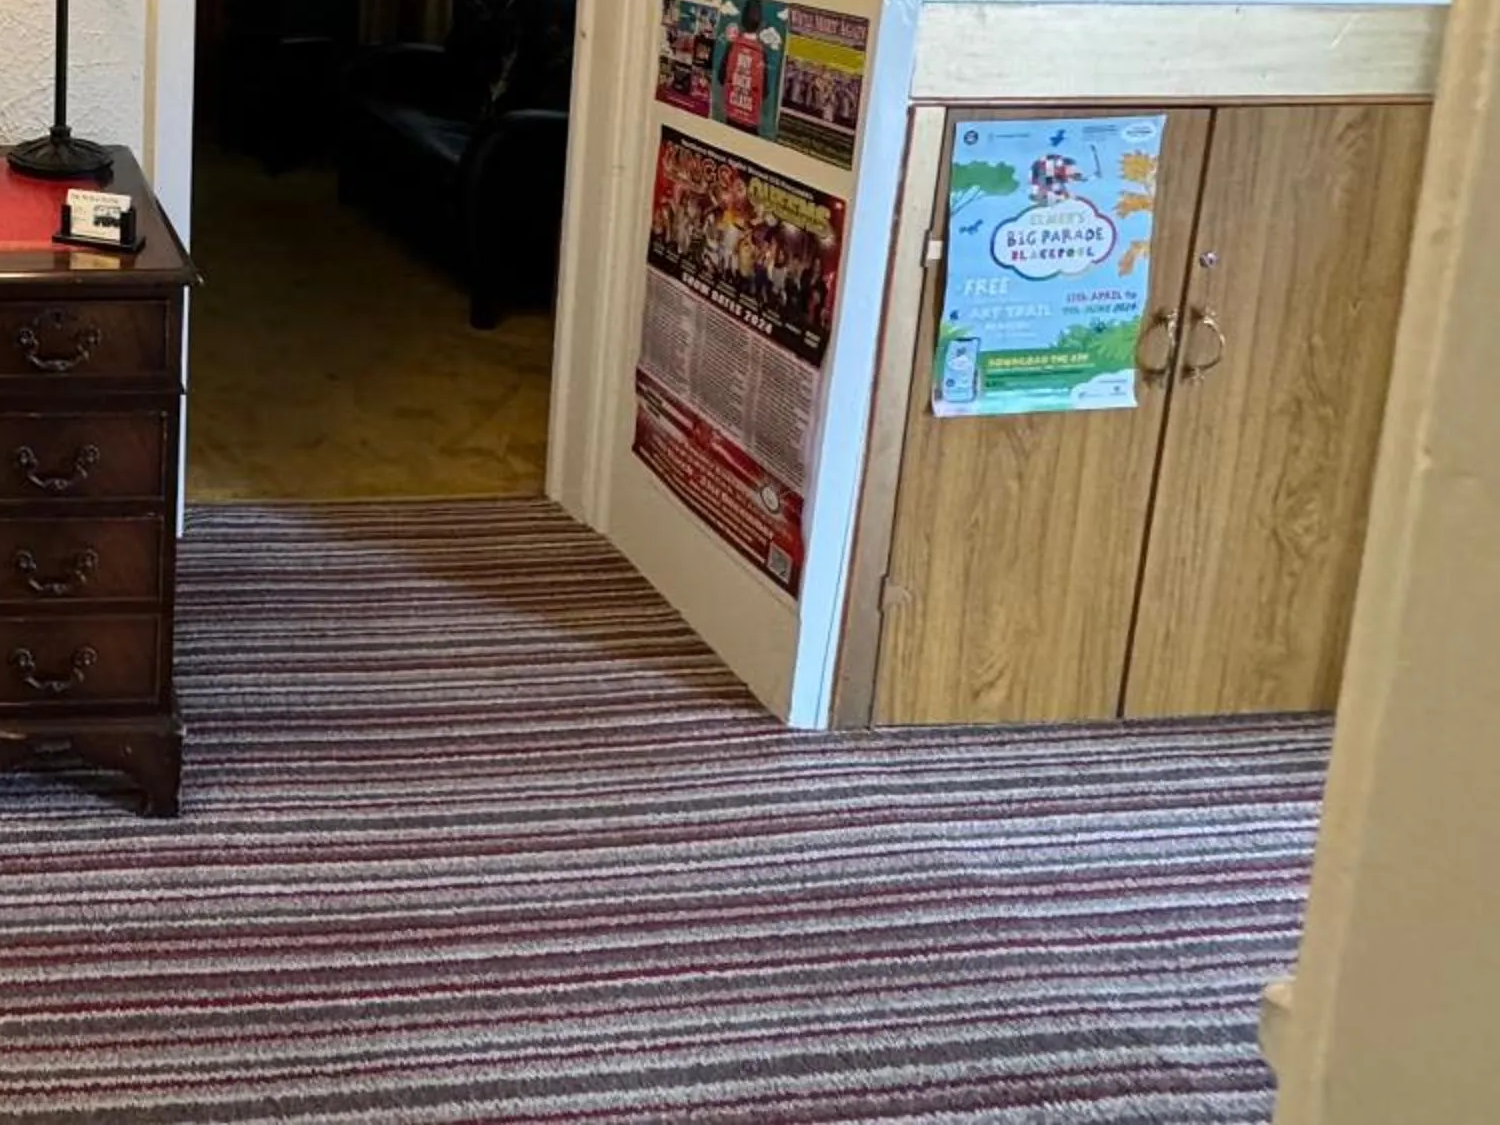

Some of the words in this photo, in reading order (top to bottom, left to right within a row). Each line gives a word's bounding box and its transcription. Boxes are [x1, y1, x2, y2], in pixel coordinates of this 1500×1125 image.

[1041, 227, 1104, 245] PARADE
[964, 277, 1010, 295] FREE
[1091, 290, 1122, 301] APRIL
[743, 309, 773, 335] 2024
